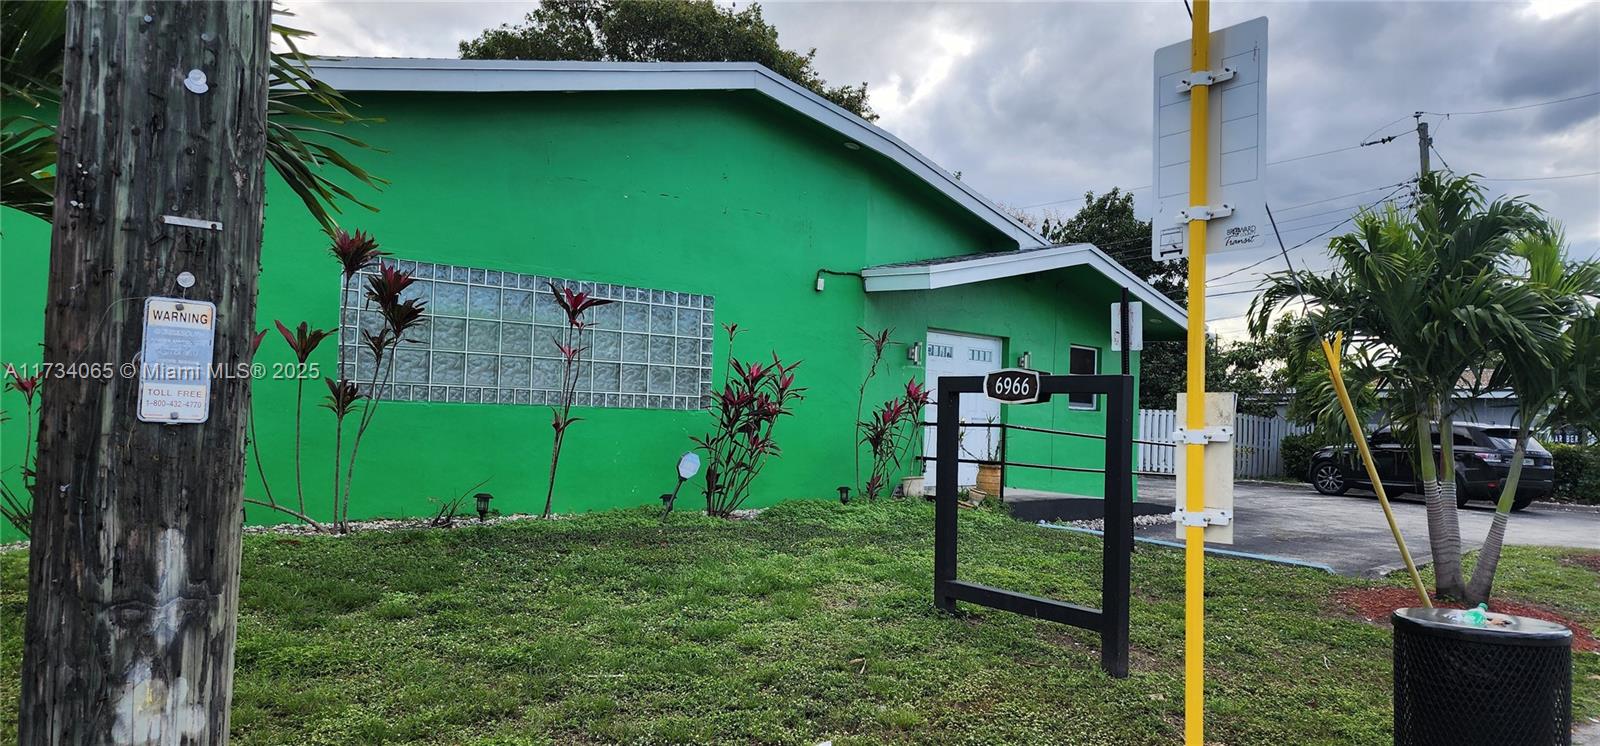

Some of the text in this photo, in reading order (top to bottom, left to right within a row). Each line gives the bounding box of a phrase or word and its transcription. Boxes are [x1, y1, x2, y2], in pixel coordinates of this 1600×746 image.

[1225, 234, 1260, 247] Transit
[152, 310, 208, 325] WARNING
[995, 377, 1029, 396] 6966
[148, 388, 202, 399] TOLL FREE
[146, 399, 202, 409] 1-800-432-4770
